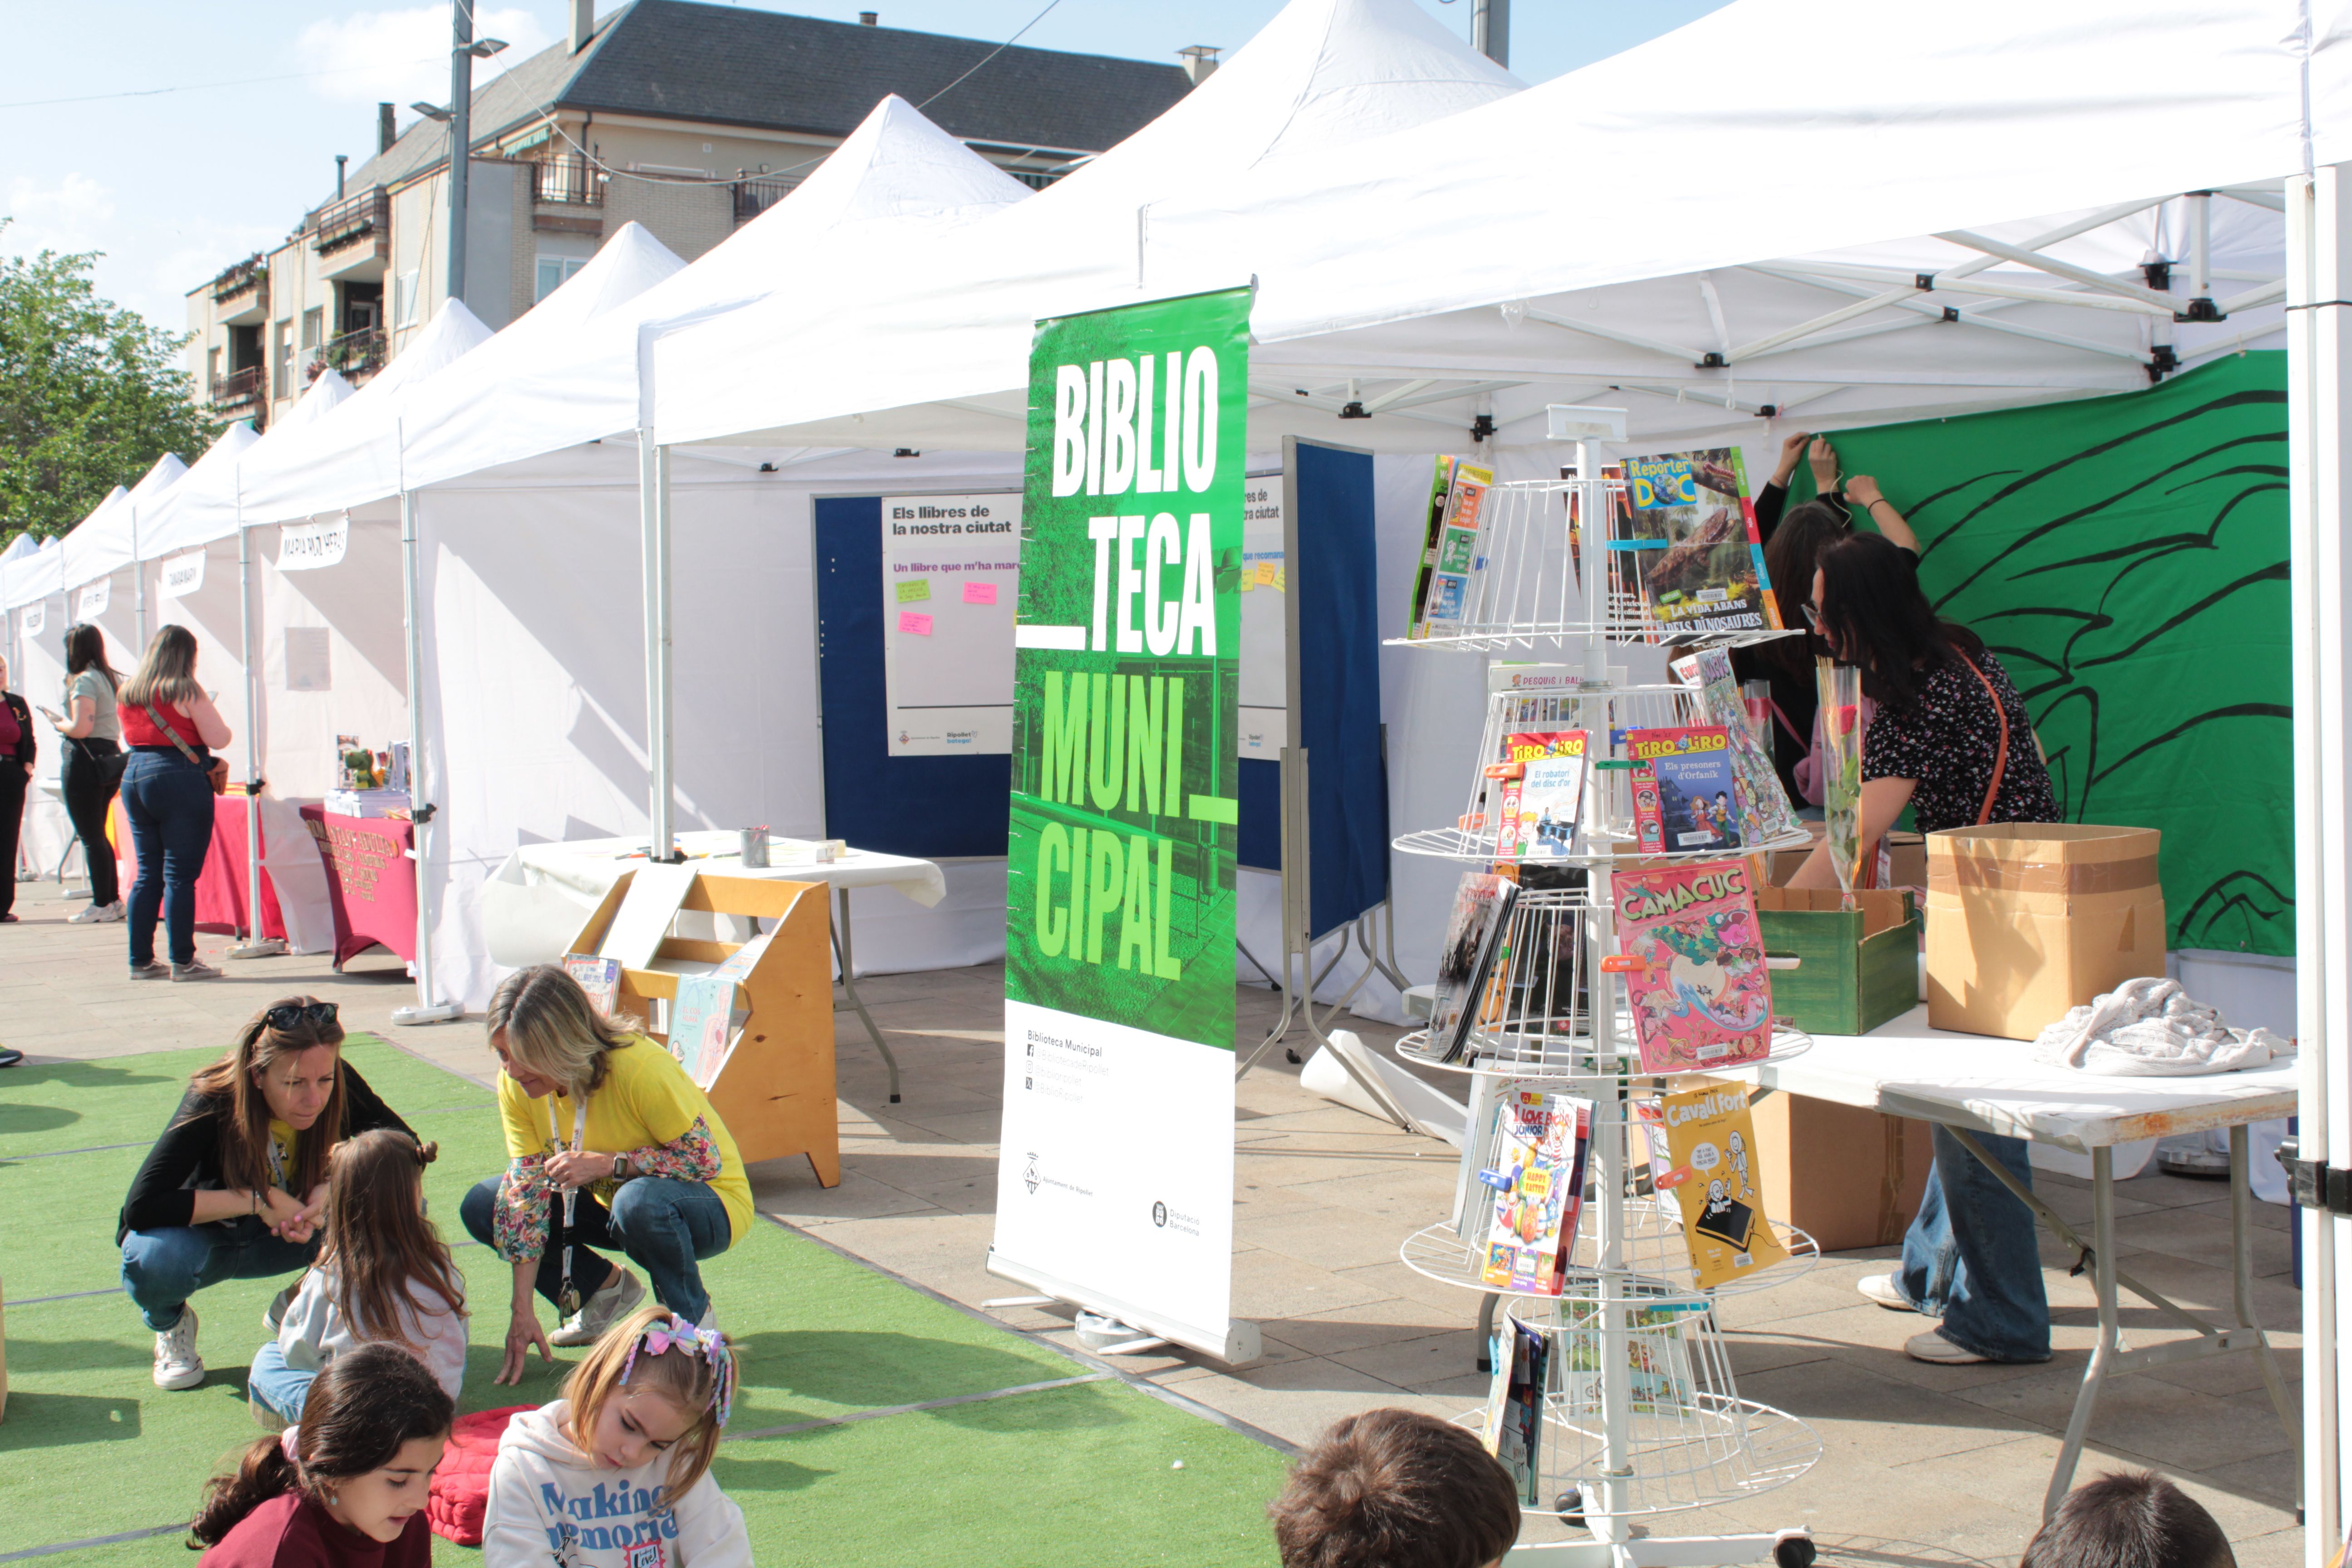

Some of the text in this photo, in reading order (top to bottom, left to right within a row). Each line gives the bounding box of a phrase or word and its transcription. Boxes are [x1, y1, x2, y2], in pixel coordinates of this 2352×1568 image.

[1052, 345, 1218, 497] BIBLIO
[1629, 459, 1690, 477] Reporter
[1258, 489, 1267, 501] de
[893, 505, 990, 519] Els llibres de
[1255, 505, 1279, 519] ciutat
[893, 521, 1011, 535] la nostra ciutat
[284, 536, 307, 557] MARIA
[1243, 553, 1253, 562] que
[894, 564, 907, 572] Un
[911, 563, 938, 571] llibre
[941, 564, 961, 573] que
[1671, 604, 1684, 617] LA
[1713, 598, 1747, 612] ABANS
[1666, 618, 1692, 631] DELS
[1041, 671, 1184, 818] MUNI
[1543, 769, 1570, 778] robatori
[1678, 770, 1719, 779] d'Orfanik
[1681, 762, 1721, 771] presoners
[1531, 779, 1541, 788] del
[1035, 822, 1181, 981] CIPAL
[1620, 868, 1746, 920] CAMACUC
[690, 1007, 701, 1015] COS
[1028, 1029, 1102, 1058] Biblioteca Municipal
[1035, 1049, 1109, 1077] @BibliotecadeRipollet
[1034, 1065, 1082, 1087] @biblioripollet
[1034, 1081, 1083, 1104] @BiblioRipollet
[1513, 1104, 1519, 1122] I
[1521, 1109, 1543, 1124] LOVE
[1667, 1090, 1746, 1127] Cavall Fort
[1527, 1171, 1547, 1183] HAPPY
[1043, 1176, 1068, 1190] Ajuntament
[1076, 1186, 1093, 1197] Ripollet
[1525, 1183, 1545, 1194] EASTER
[1170, 1209, 1200, 1226] Diputació
[1170, 1220, 1200, 1237] Barcelona
[1513, 1447, 1526, 1459] BONA
[541, 1479, 673, 1521] Making
